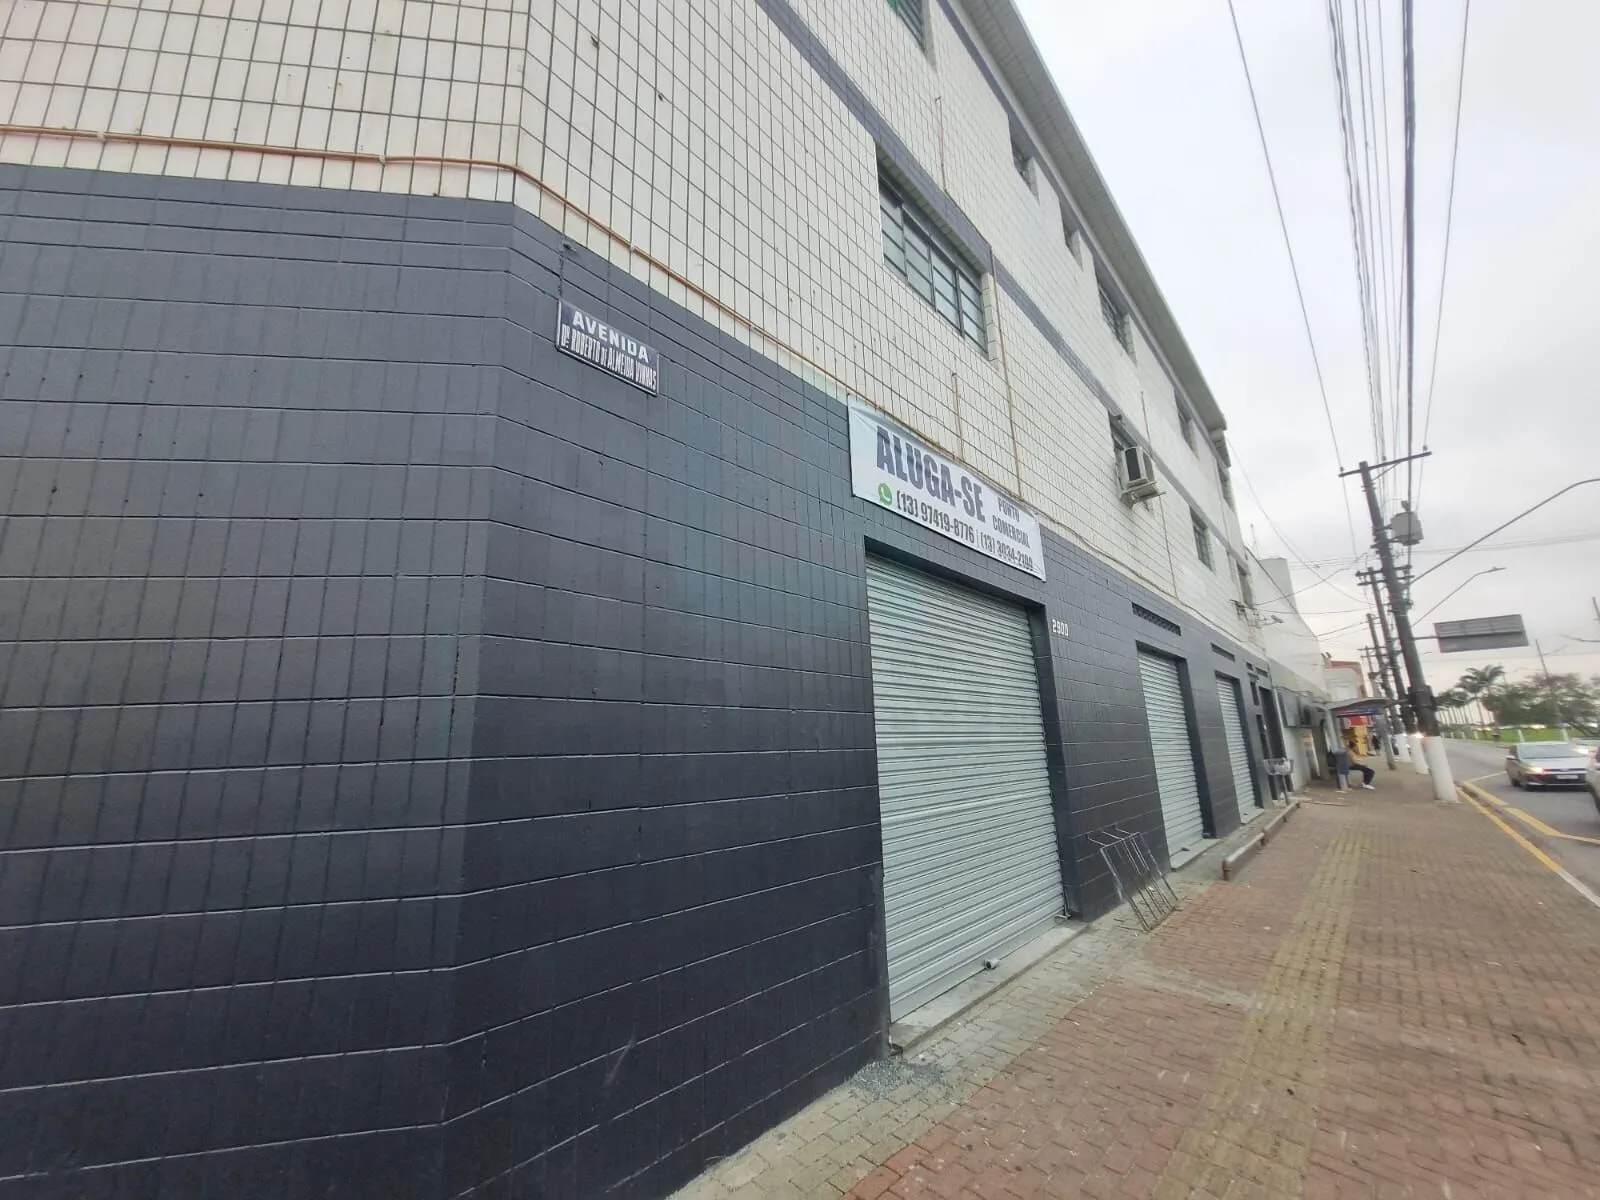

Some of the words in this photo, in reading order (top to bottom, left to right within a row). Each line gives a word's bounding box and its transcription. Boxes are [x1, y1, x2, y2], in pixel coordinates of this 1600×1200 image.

[571, 328, 601, 363] ROBERTO
[607, 346, 634, 380] ALMEIDA
[635, 362, 657, 391] VINHAS
[572, 311, 649, 363] AVENIDA
[876, 425, 986, 524] ALUGA-SE
[896, 490, 919, 517] (13)
[921, 502, 975, 543] 97419-8776
[980, 531, 996, 555] (13)
[992, 515, 1030, 549] COMERCIAL
[997, 496, 1020, 522] PONTO
[1052, 619, 1069, 637] 2900
